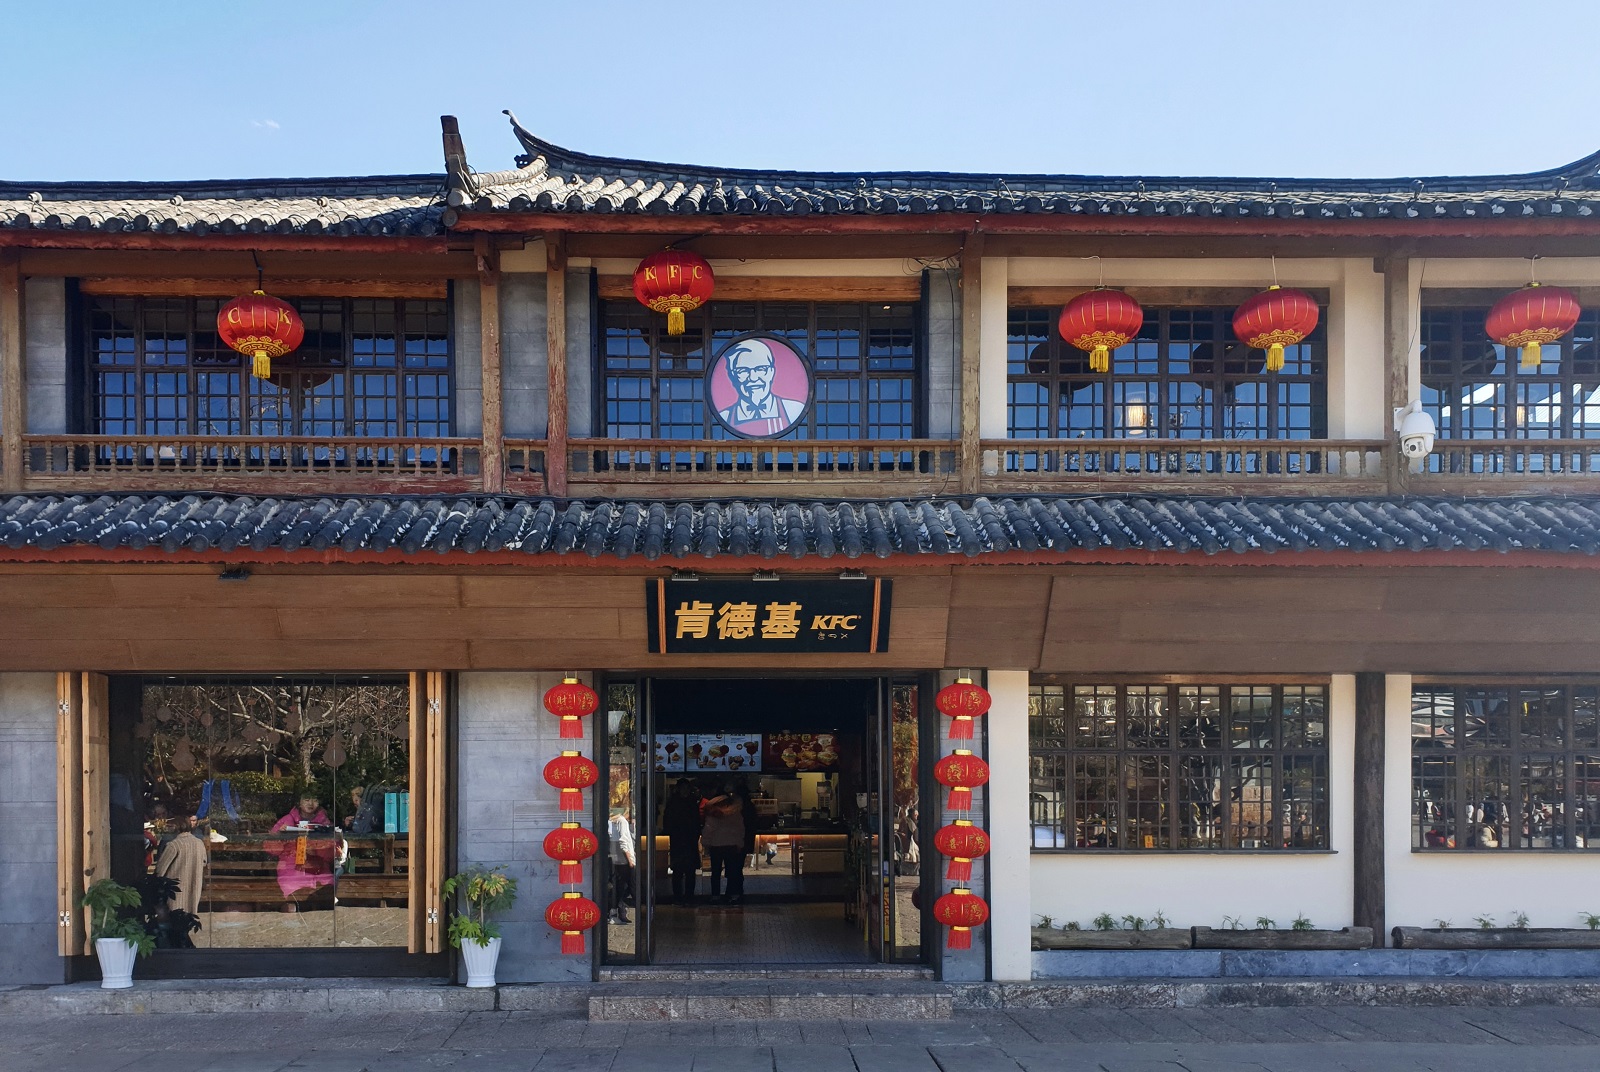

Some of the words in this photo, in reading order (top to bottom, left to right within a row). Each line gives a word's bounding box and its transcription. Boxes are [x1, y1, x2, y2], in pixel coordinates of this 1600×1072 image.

[279, 307, 291, 325] K
[674, 600, 802, 640] 肯德基
[810, 614, 858, 630] KFC
